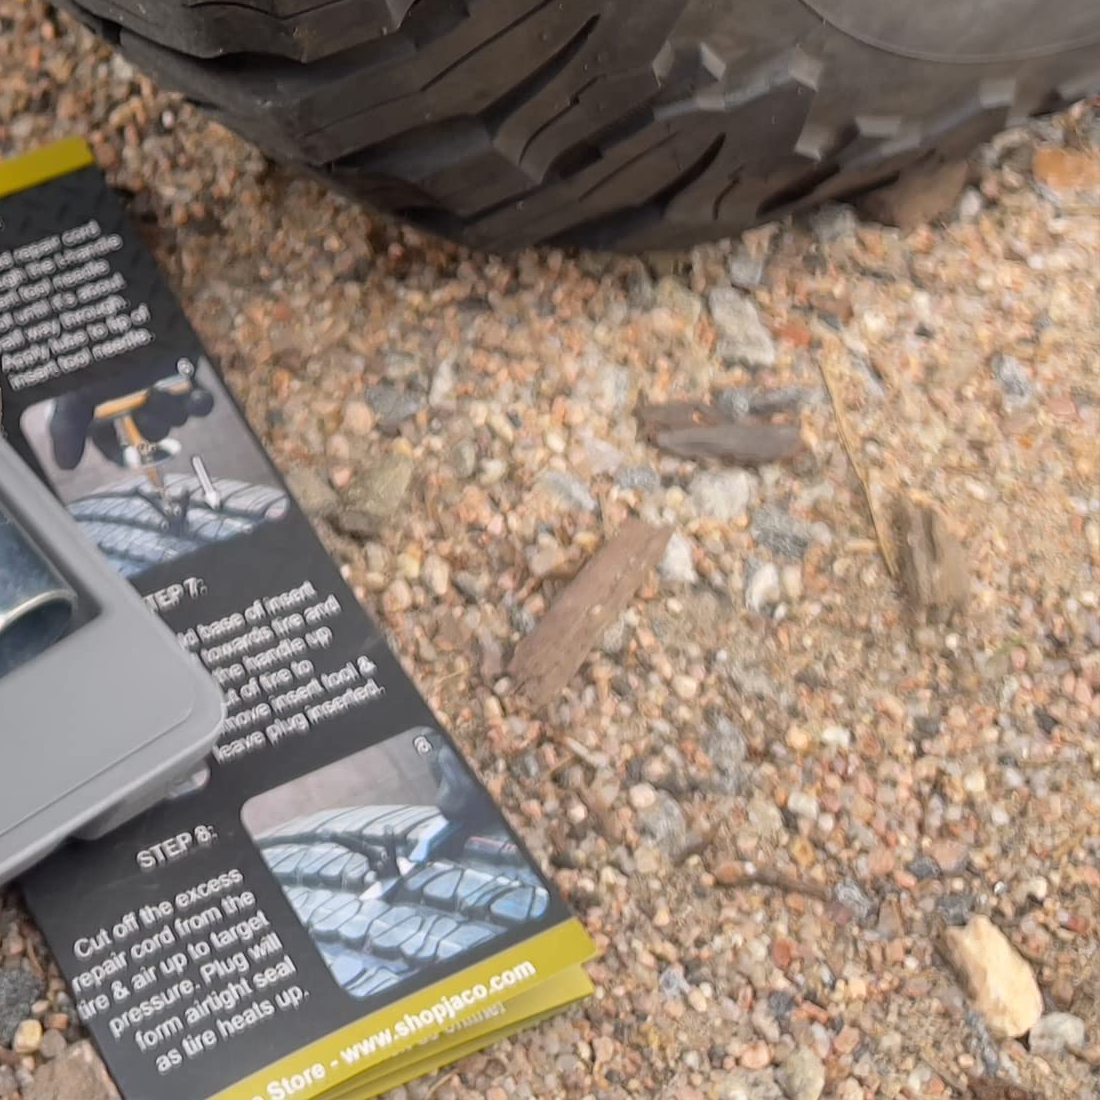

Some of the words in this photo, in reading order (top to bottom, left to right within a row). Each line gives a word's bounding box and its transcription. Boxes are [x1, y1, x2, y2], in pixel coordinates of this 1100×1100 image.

[141, 583, 184, 613] TEP
[197, 613, 245, 644] base
[245, 599, 266, 622] of
[263, 580, 317, 616] insert
[200, 626, 274, 667] towards
[303, 594, 342, 627] and
[240, 677, 262, 701] of
[291, 659, 315, 681] to
[242, 637, 307, 674] handle
[304, 626, 333, 650] up
[268, 678, 324, 714] insert
[321, 662, 360, 693] tool
[212, 731, 266, 765] leave
[266, 712, 309, 747] plug
[136, 832, 192, 870] STEP
[72, 952, 128, 993] repair
[131, 926, 175, 961] cord
[174, 907, 223, 940] from
[221, 891, 255, 917] the
[74, 929, 112, 960] Cut
[112, 913, 139, 941] off
[139, 901, 173, 928] the
[175, 869, 244, 909] excess
[77, 994, 110, 1021] tire
[111, 980, 130, 1002] &
[131, 967, 157, 992] air
[160, 952, 187, 977] up
[187, 941, 211, 961] to
[210, 910, 271, 949] target
[109, 979, 201, 1039] pressure.
[200, 952, 249, 985] Plug
[248, 932, 283, 962] will
[135, 1016, 184, 1052] form
[184, 977, 253, 1025] airtight
[253, 954, 297, 990] seal
[156, 1048, 182, 1074] as
[182, 1030, 217, 1058] tire
[217, 1000, 275, 1040] heats
[275, 984, 310, 1010] up.
[265, 1061, 327, 1100] Store
[339, 959, 537, 1066] www.shopjaco.com
